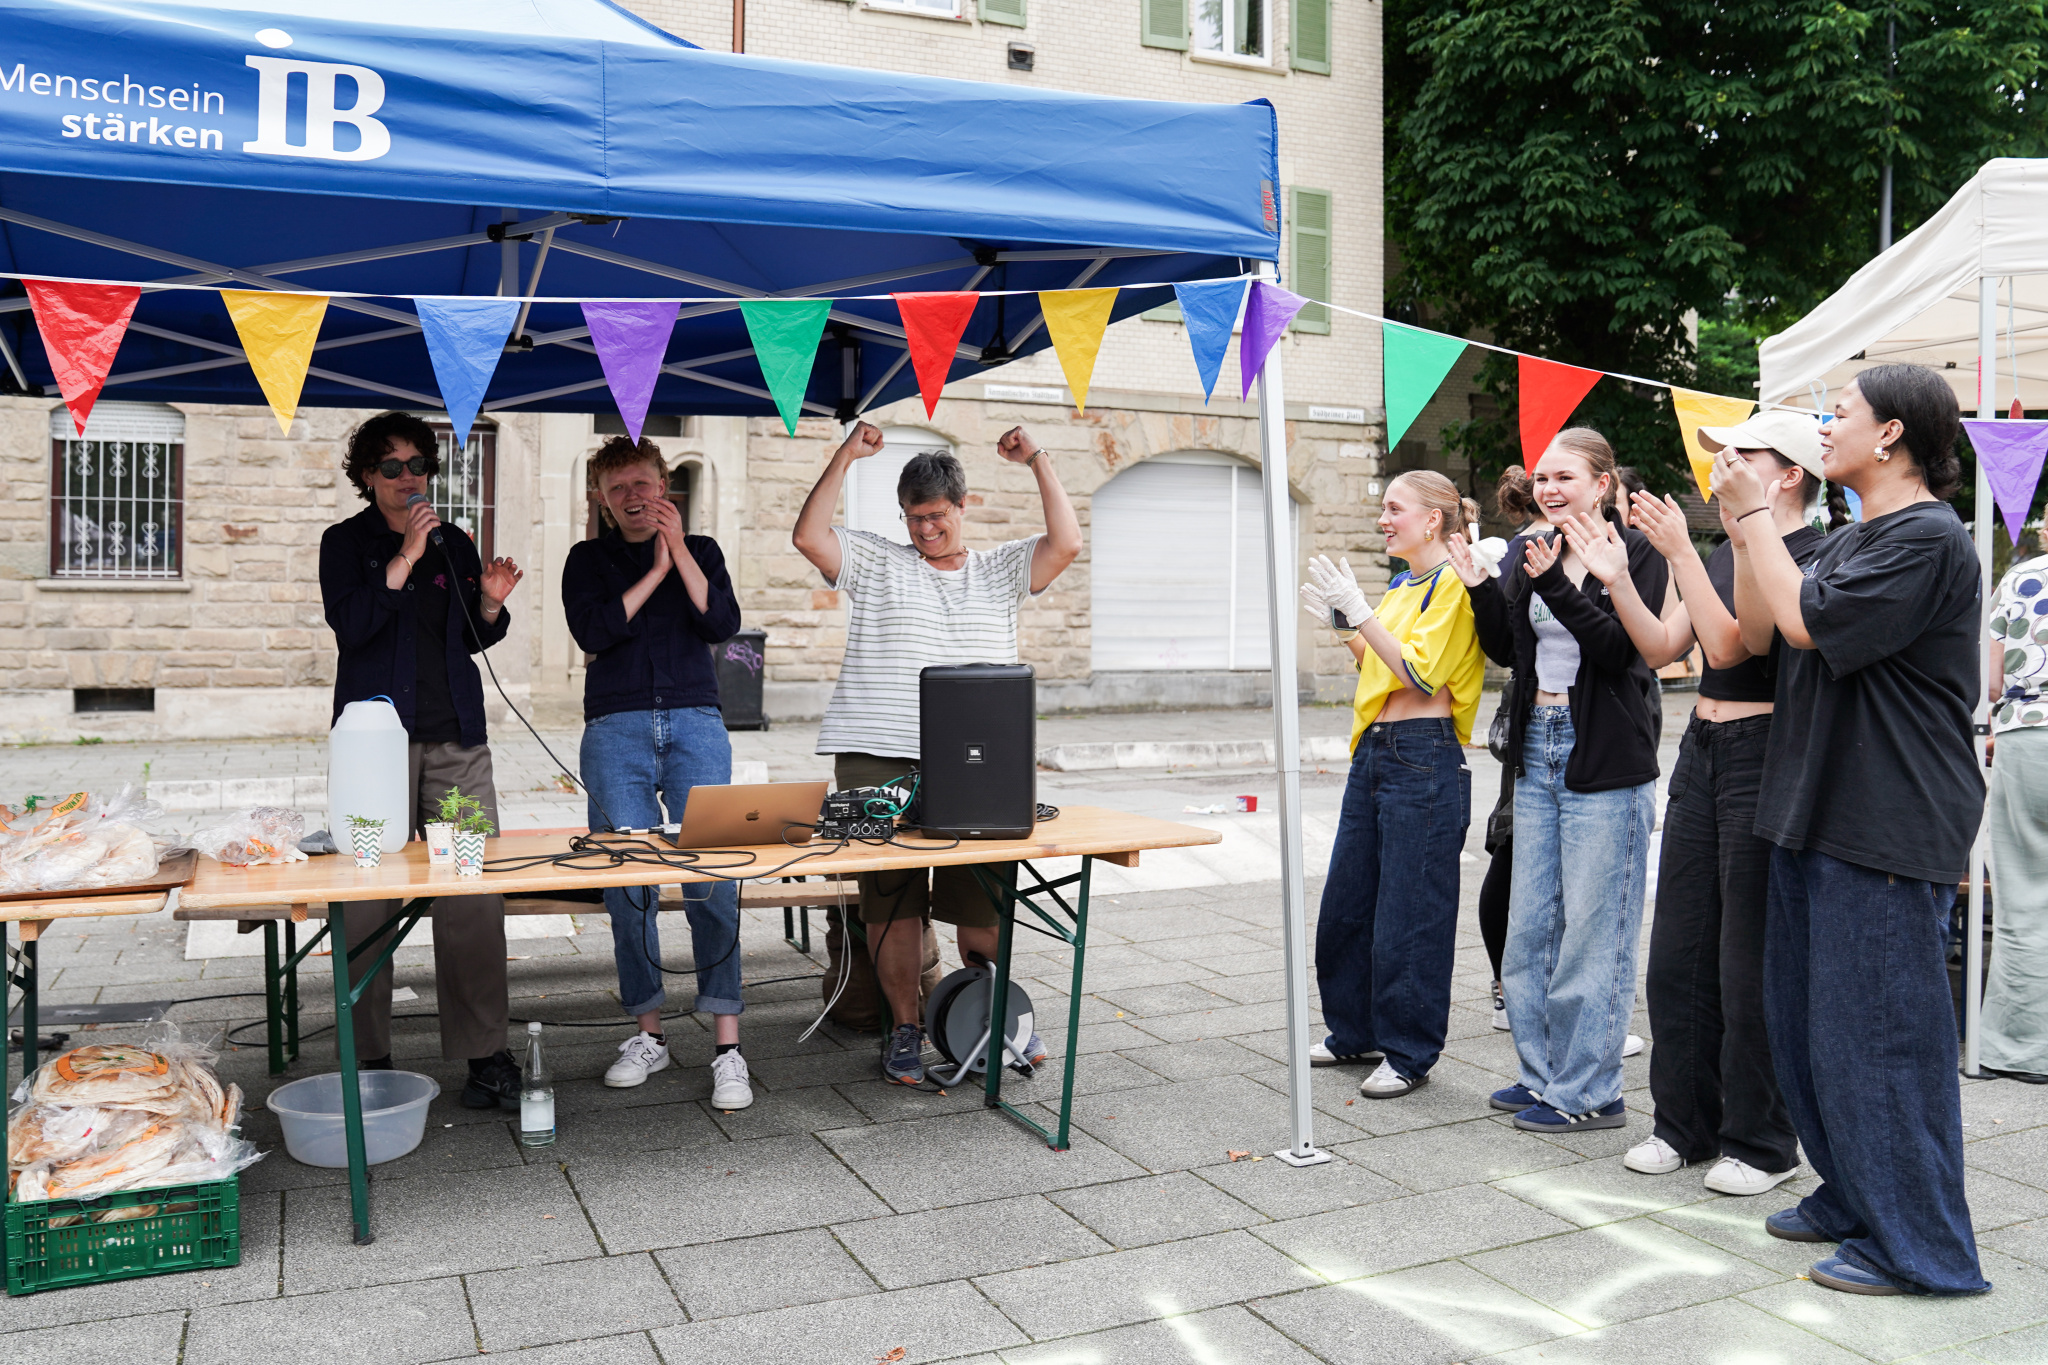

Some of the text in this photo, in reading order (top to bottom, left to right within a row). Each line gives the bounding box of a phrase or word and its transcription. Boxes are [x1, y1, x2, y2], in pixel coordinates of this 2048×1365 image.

[0, 63, 225, 115] Menschsein
[61, 111, 224, 151] stärken
[1263, 190, 1274, 221] RUKU
[1312, 408, 1361, 421] Südheimer Platz
[1534, 602, 1555, 623] SAIN
